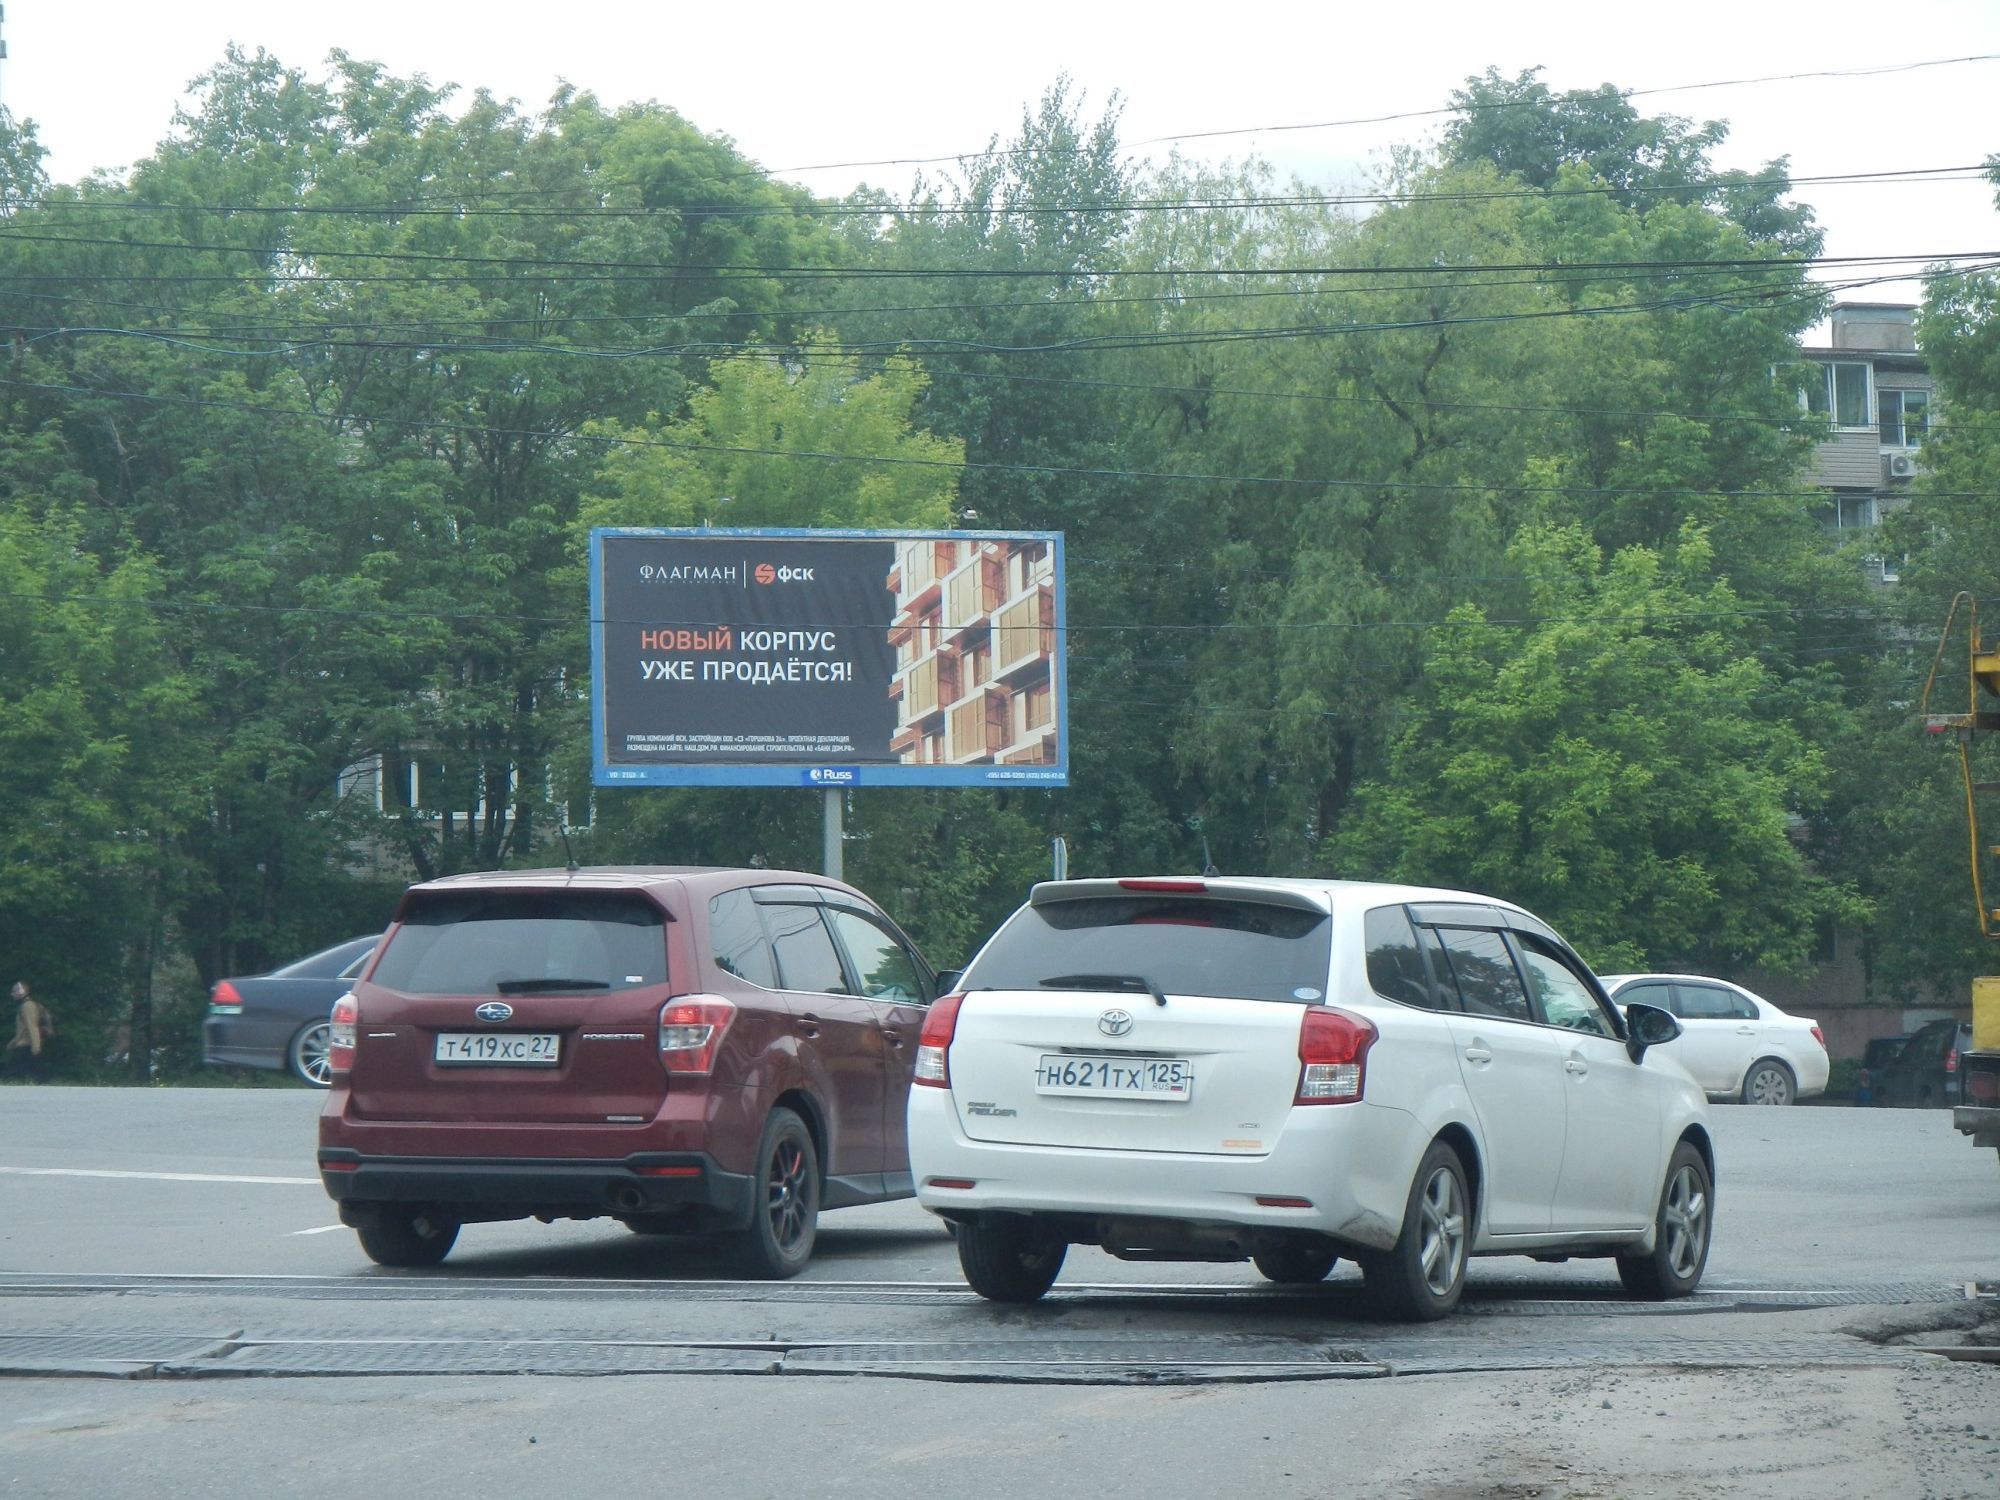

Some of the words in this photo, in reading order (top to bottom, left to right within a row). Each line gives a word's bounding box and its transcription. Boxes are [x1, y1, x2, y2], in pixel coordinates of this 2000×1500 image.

[640, 564, 736, 579] ФЛАГМАН
[777, 565, 815, 582] ФСК
[641, 626, 732, 650] НОВЫЙ
[740, 631, 836, 651] КОРПУС
[640, 661, 695, 680] УЖЕ
[703, 657, 852, 685] ПРОДАЁТСЯ!
[626, 734, 646, 742] ГРУППА
[646, 733, 675, 742] КОМПАНИЙ
[688, 734, 722, 743] ЗАСТРОЙЩИК
[787, 735, 817, 743] ПРОЕКТНАЯ
[817, 735, 850, 743] ДЕКЛАРАЦИЯ
[626, 744, 658, 752] РАЗМЕЩЕНА
[765, 744, 805, 752] СТРОИТЕЛЬСТВА
[823, 769, 853, 780] Russ
[582, 1033, 645, 1041] FORESTER
[531, 1037, 552, 1053] 27
[1147, 1063, 1182, 1083] 125
[1152, 1082, 1170, 1091] RUS
[967, 1107, 1017, 1118] FIELDER
